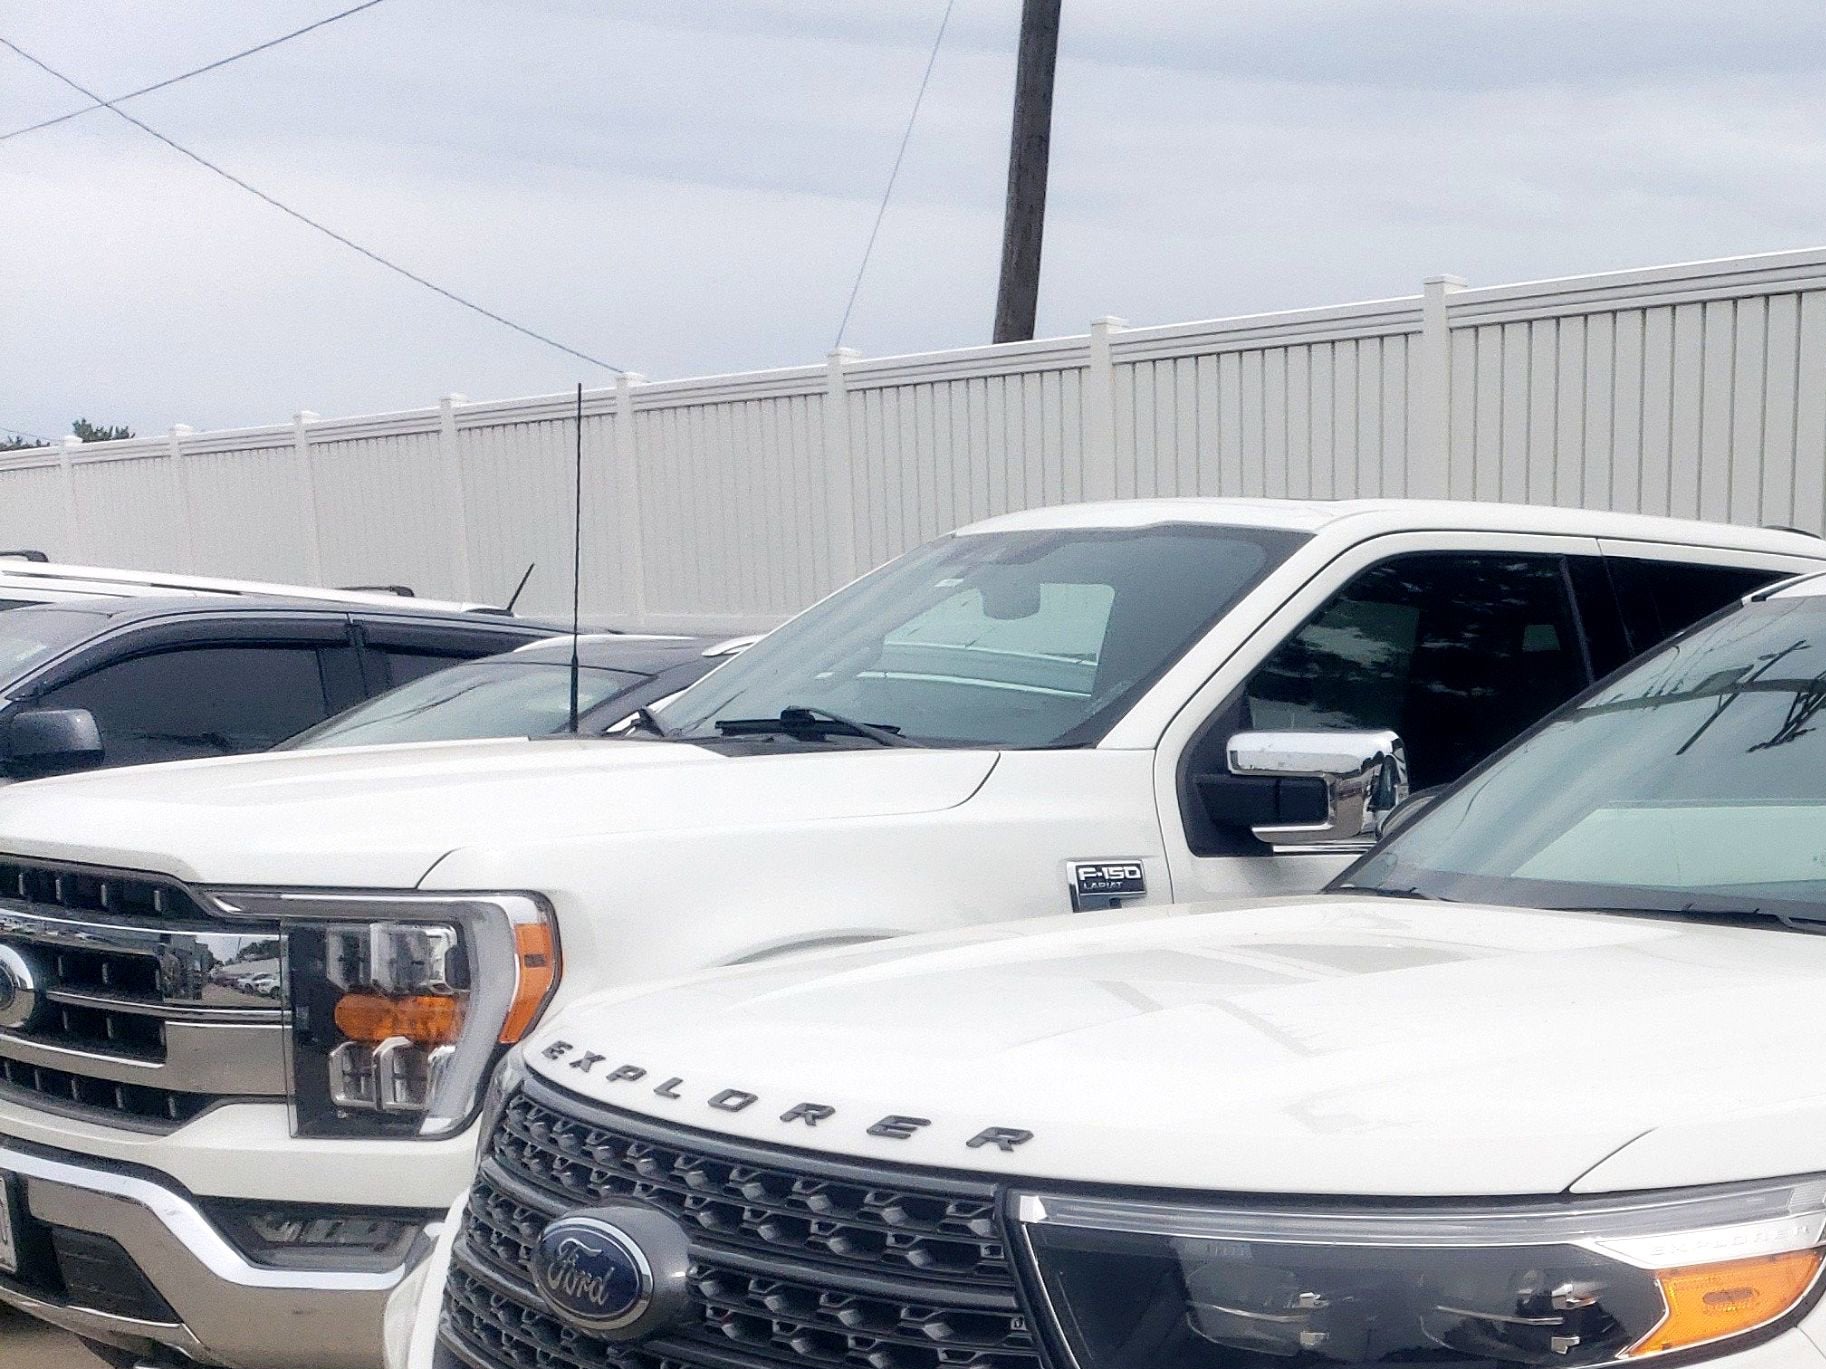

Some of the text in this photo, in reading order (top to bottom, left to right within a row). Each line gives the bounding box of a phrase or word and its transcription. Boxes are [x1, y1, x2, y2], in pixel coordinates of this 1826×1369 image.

[1077, 865, 1142, 881] F-150
[1083, 880, 1124, 890] LARIAT
[541, 1040, 1035, 1152] EXPLORER
[547, 1237, 615, 1305] Ford
